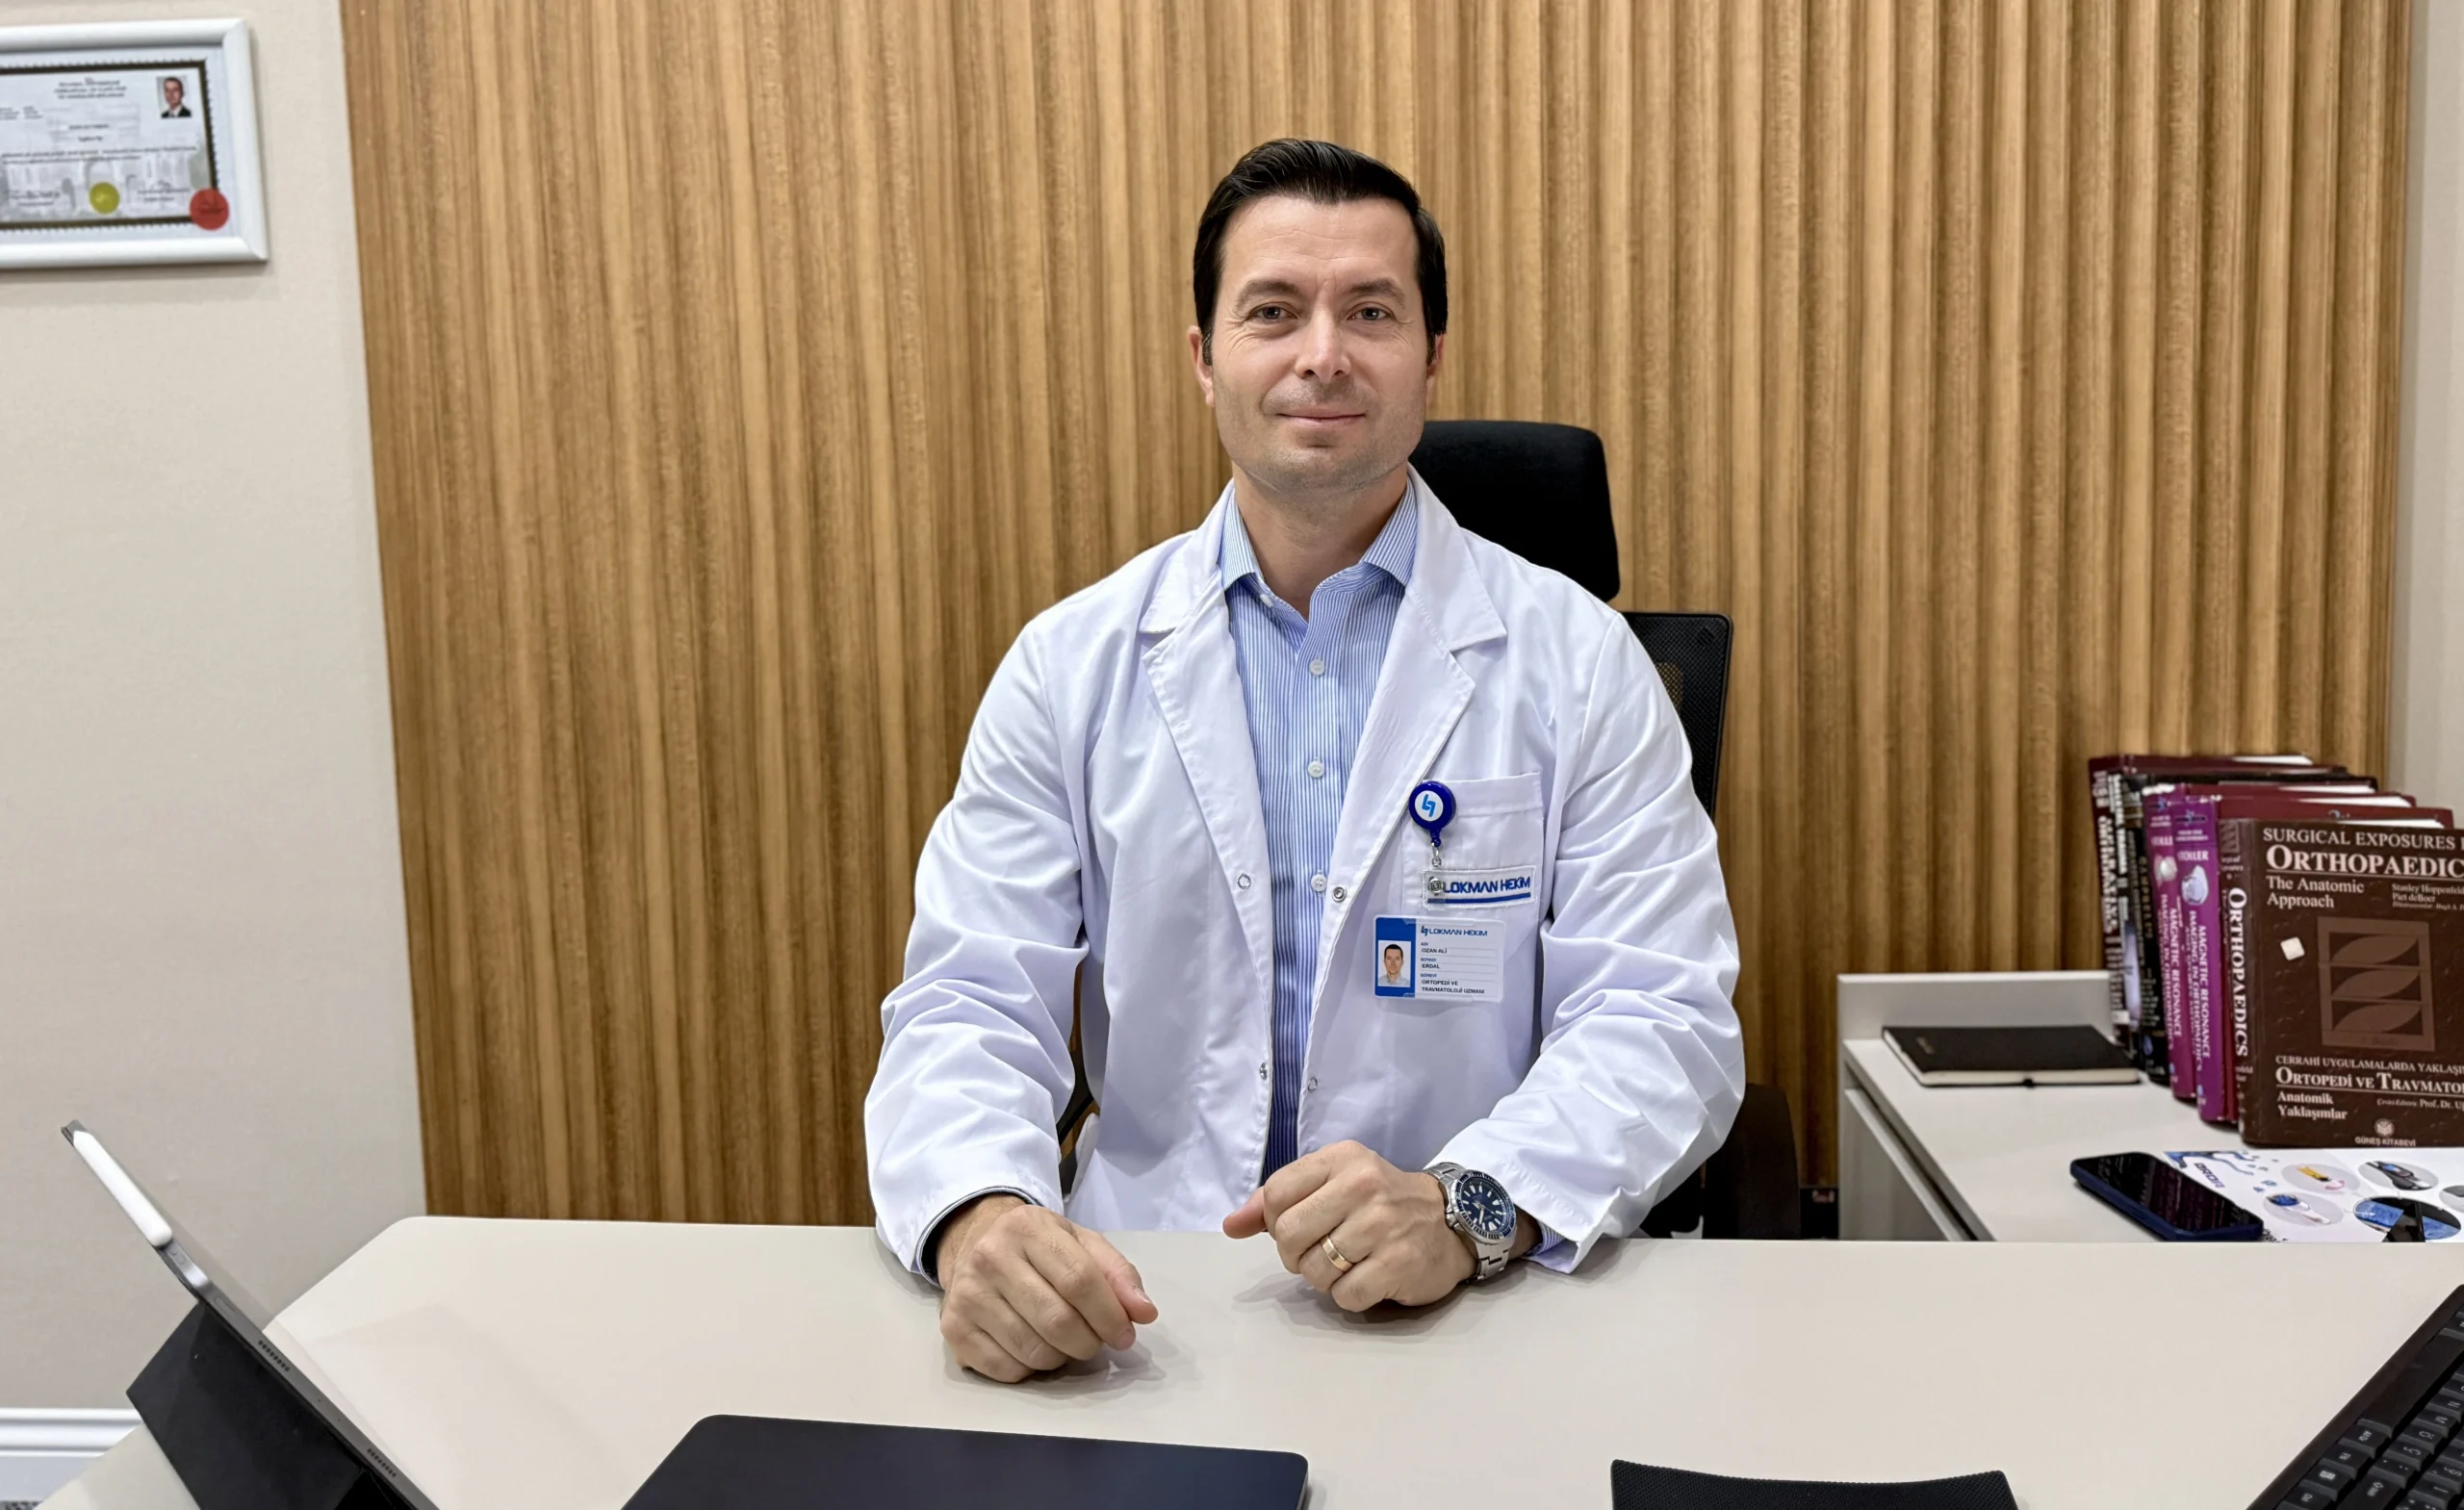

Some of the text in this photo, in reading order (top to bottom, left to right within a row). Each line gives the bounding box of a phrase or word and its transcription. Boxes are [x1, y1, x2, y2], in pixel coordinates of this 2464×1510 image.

[2263, 828, 2351, 845] SURGICAL
[2356, 832, 2455, 850] EXPOSURES
[2266, 844, 2464, 878] ORTHOPAEDIC
[1443, 880, 1498, 893] LOKMAN
[2266, 875, 2364, 894] The Anatomic
[2392, 883, 2419, 894] Stanley
[2267, 893, 2335, 909] Approach
[2392, 892, 2407, 901] Piet
[2169, 908, 2180, 965] MAGNETIC
[2188, 910, 2199, 962] IMAGING
[2228, 887, 2248, 1057] ORTHOPAEDICS
[2197, 925, 2211, 1058] MAGNETIC RESONANCE
[2170, 969, 2182, 1036] RESONANCE
[2191, 982, 2203, 1070] ORTHOPAEDICS
[2276, 1055, 2321, 1067] CERRAHİ
[2322, 1056, 2416, 1072] UYGULAMALARDA
[2276, 1066, 2352, 1087] ORTOPEDİ
[2356, 1076, 2375, 1088] VE
[2277, 1091, 2334, 1104] Anatomik
[2419, 1099, 2439, 1108] Prof.
[2440, 1100, 2454, 1108] Dr.
[2277, 1105, 2348, 1120] Yaklaşımlar
[2355, 1136, 2381, 1146] GÜNEŞ
[2419, 1431, 2435, 1439] Ö
[2403, 1446, 2421, 1456] Ç
